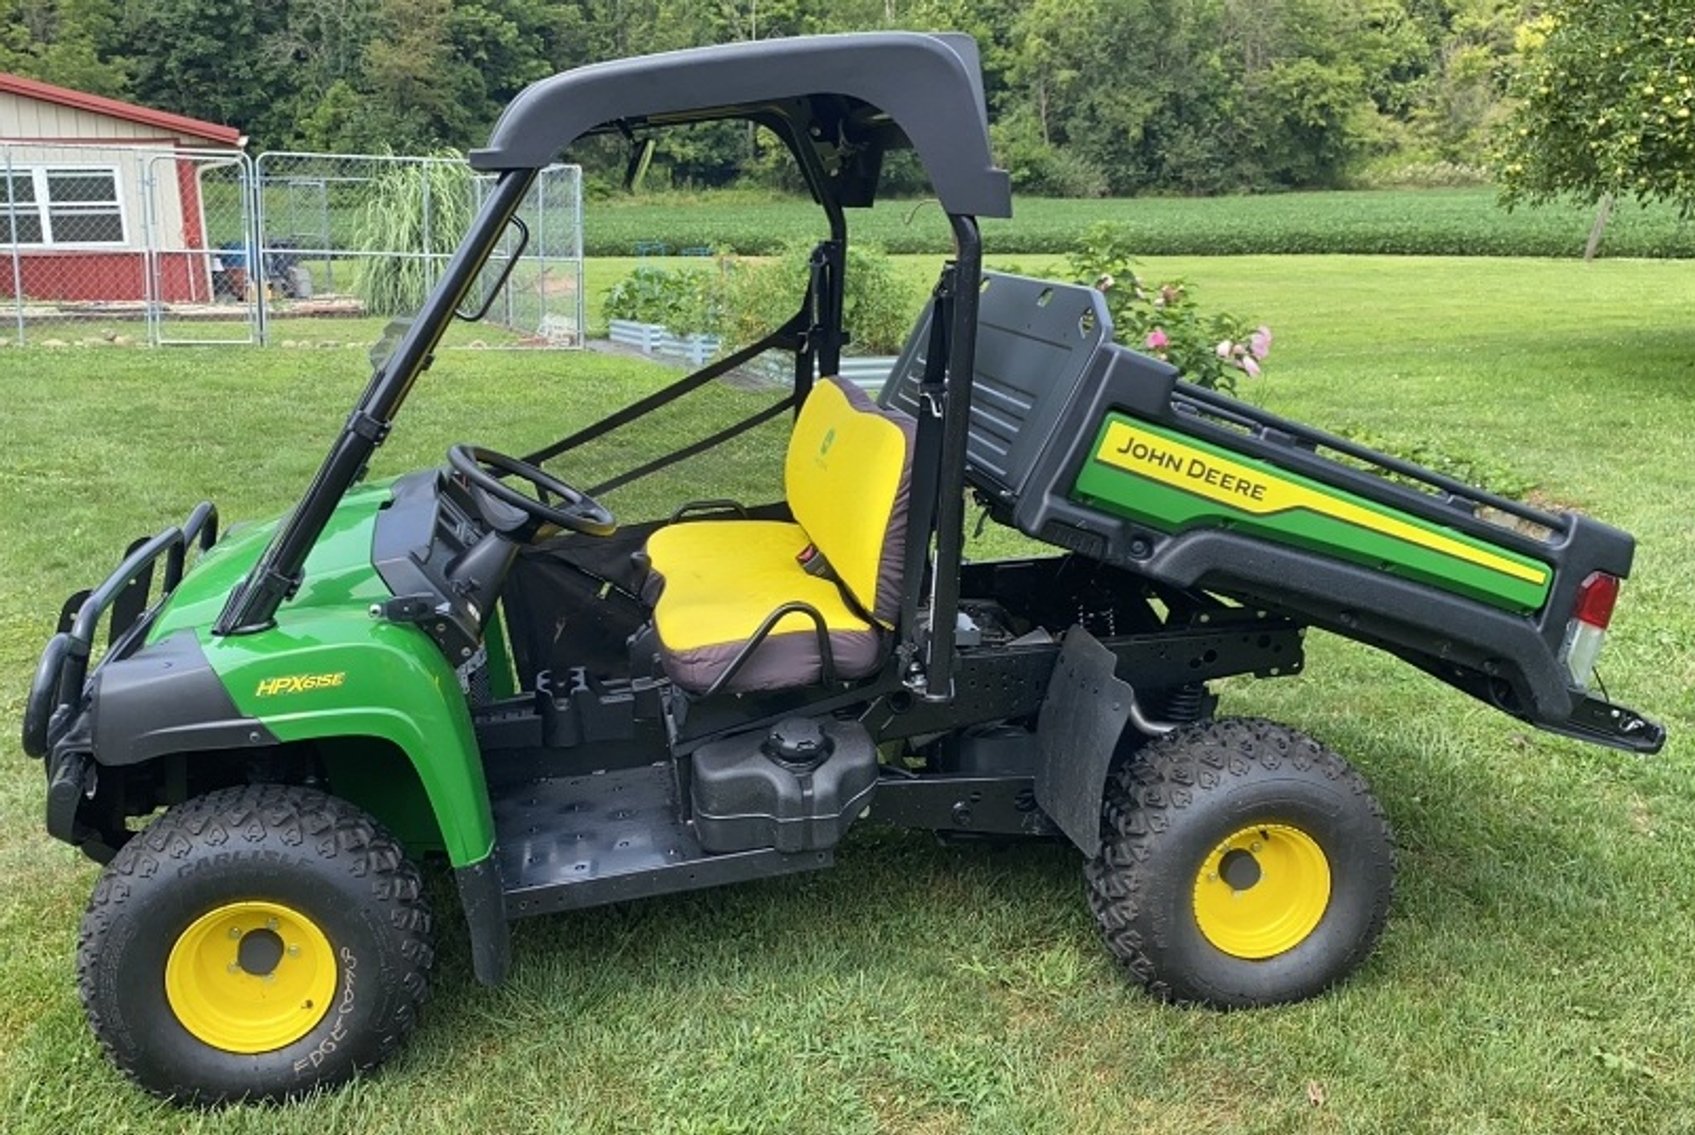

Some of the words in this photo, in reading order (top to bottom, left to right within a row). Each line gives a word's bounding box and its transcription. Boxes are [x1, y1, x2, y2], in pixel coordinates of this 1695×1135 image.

[1116, 437, 1183, 472] JOHN
[1186, 458, 1268, 502] DEERE
[255, 671, 346, 697] HPX615E
